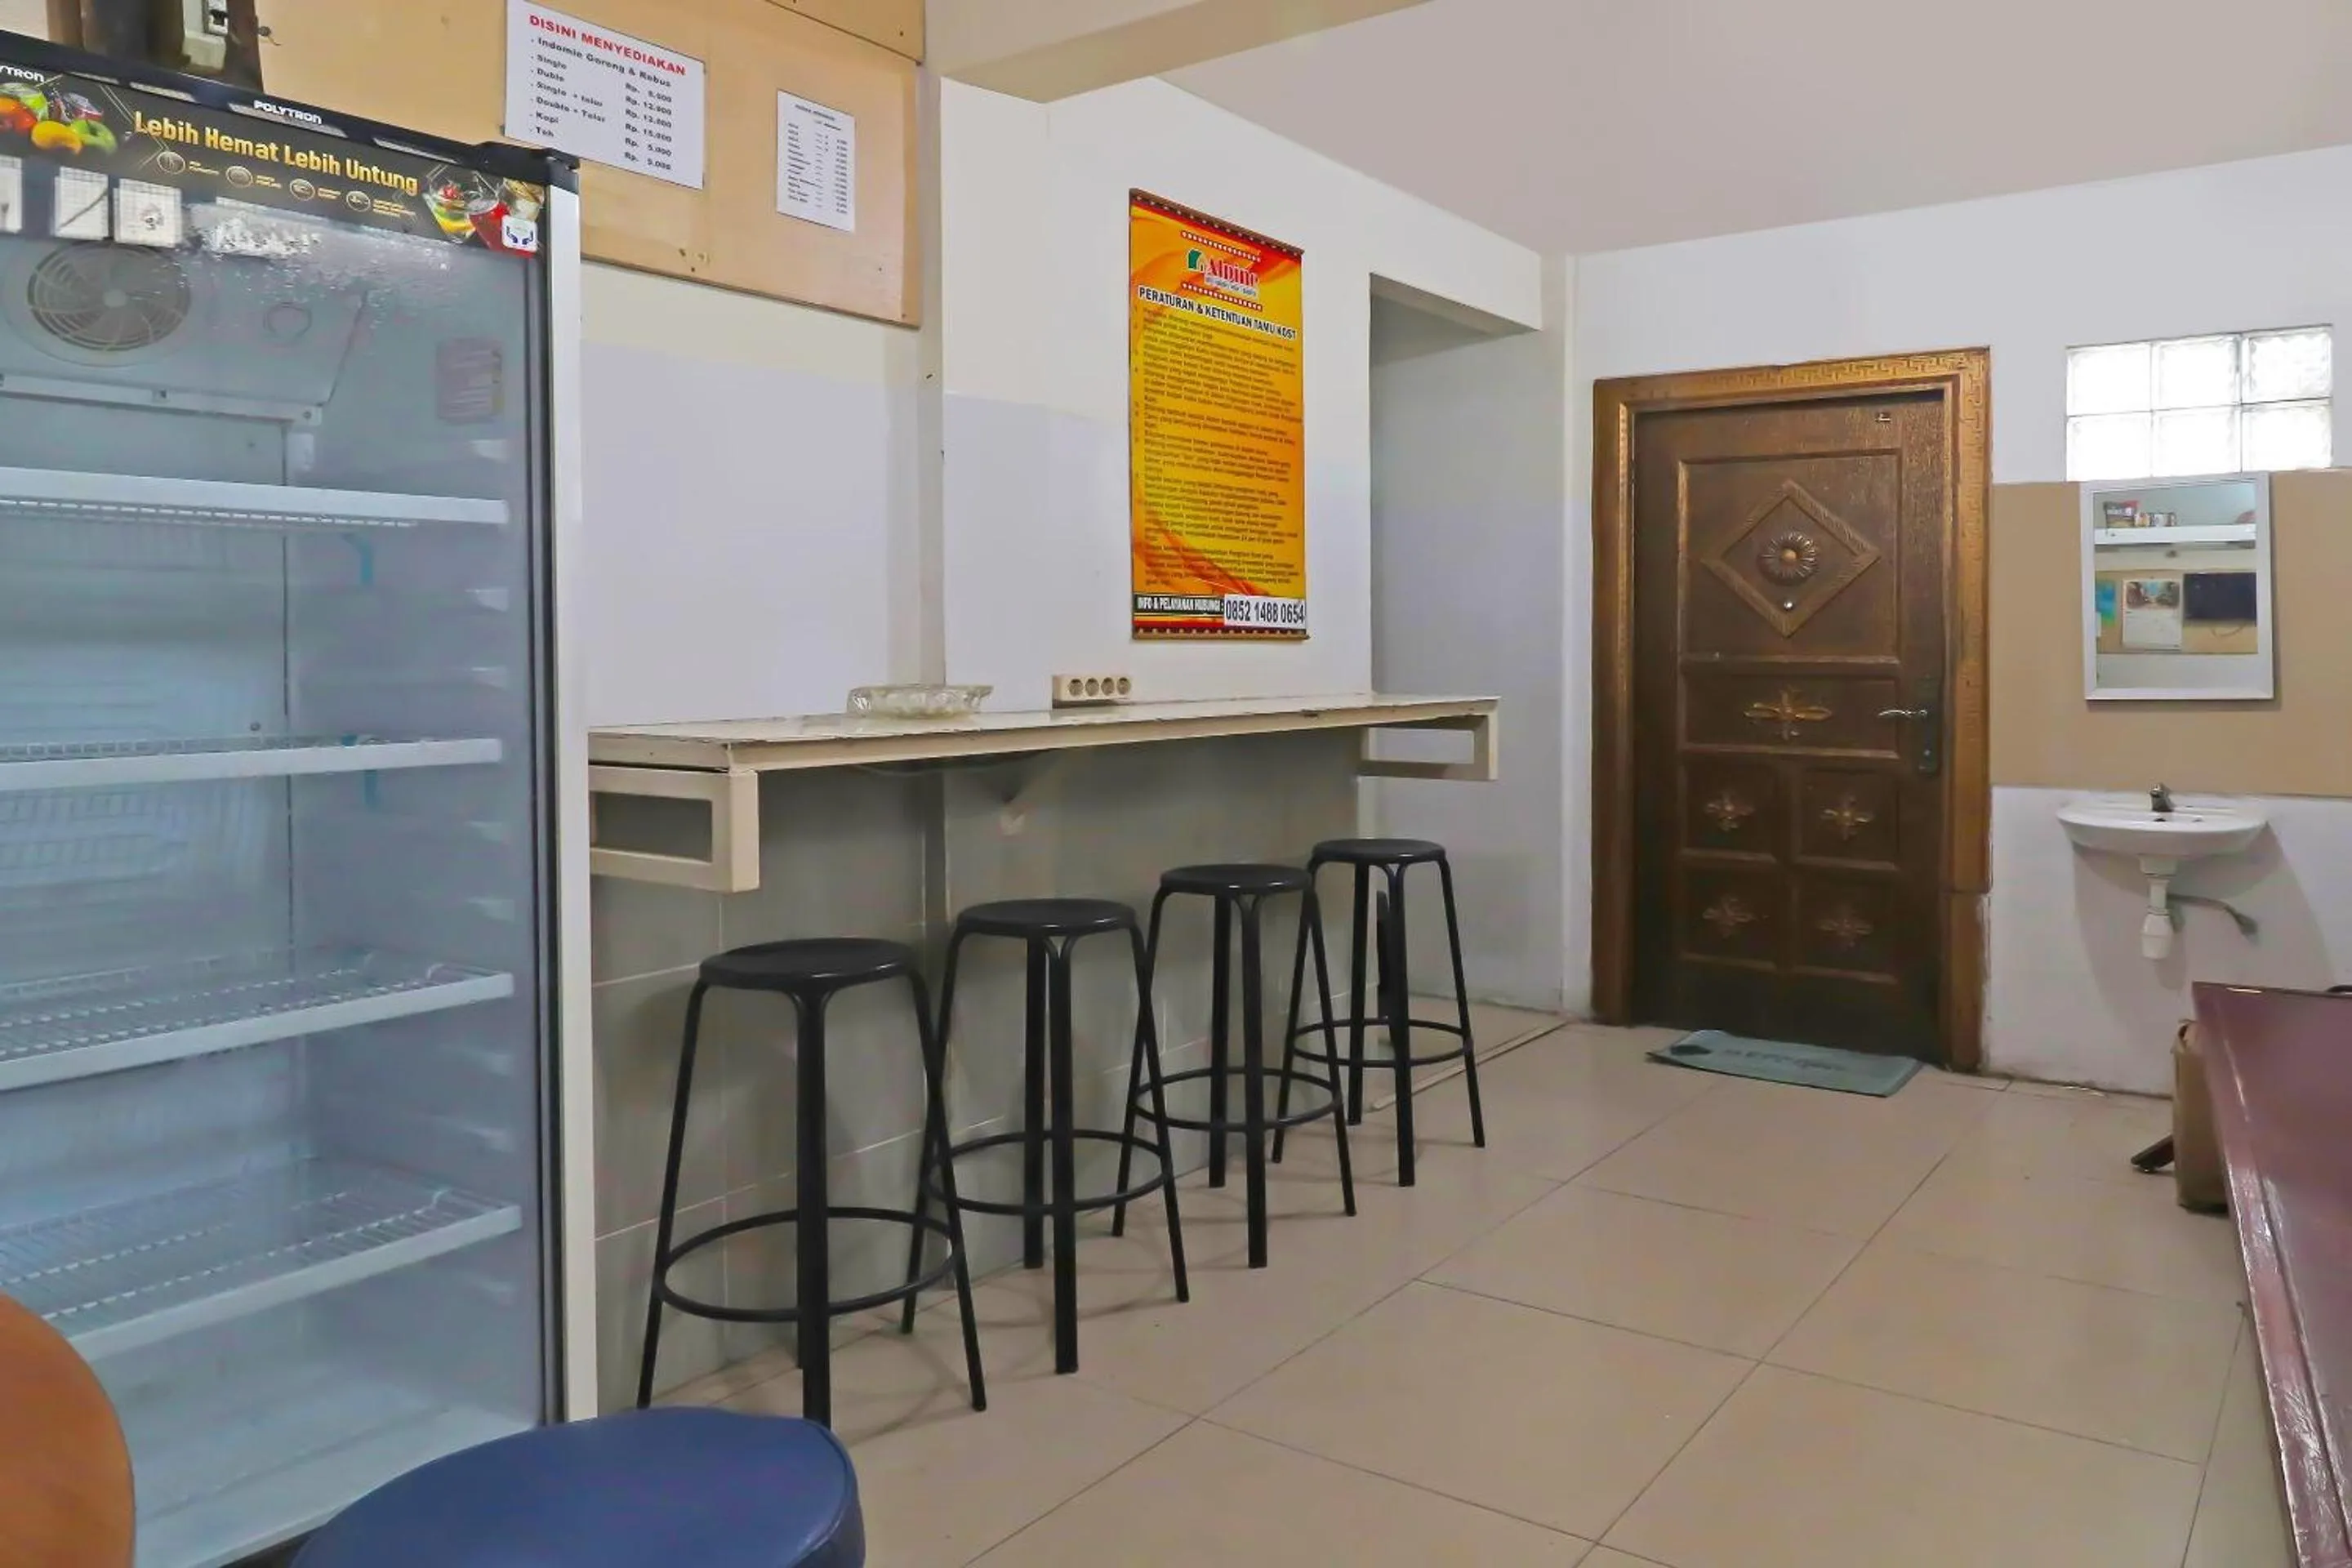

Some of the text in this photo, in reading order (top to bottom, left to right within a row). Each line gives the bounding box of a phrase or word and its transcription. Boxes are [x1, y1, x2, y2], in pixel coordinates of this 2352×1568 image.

[529, 15, 686, 76] DISINI MENYEDIAKAN
[538, 37, 582, 58] Indomie
[134, 110, 418, 197] Lebih Hemat Lebih Untung
[1138, 287, 1194, 313] PERATURAN
[1205, 305, 1252, 328] KETENTUAN
[1226, 599, 1306, 624] 0852 1488 0654
